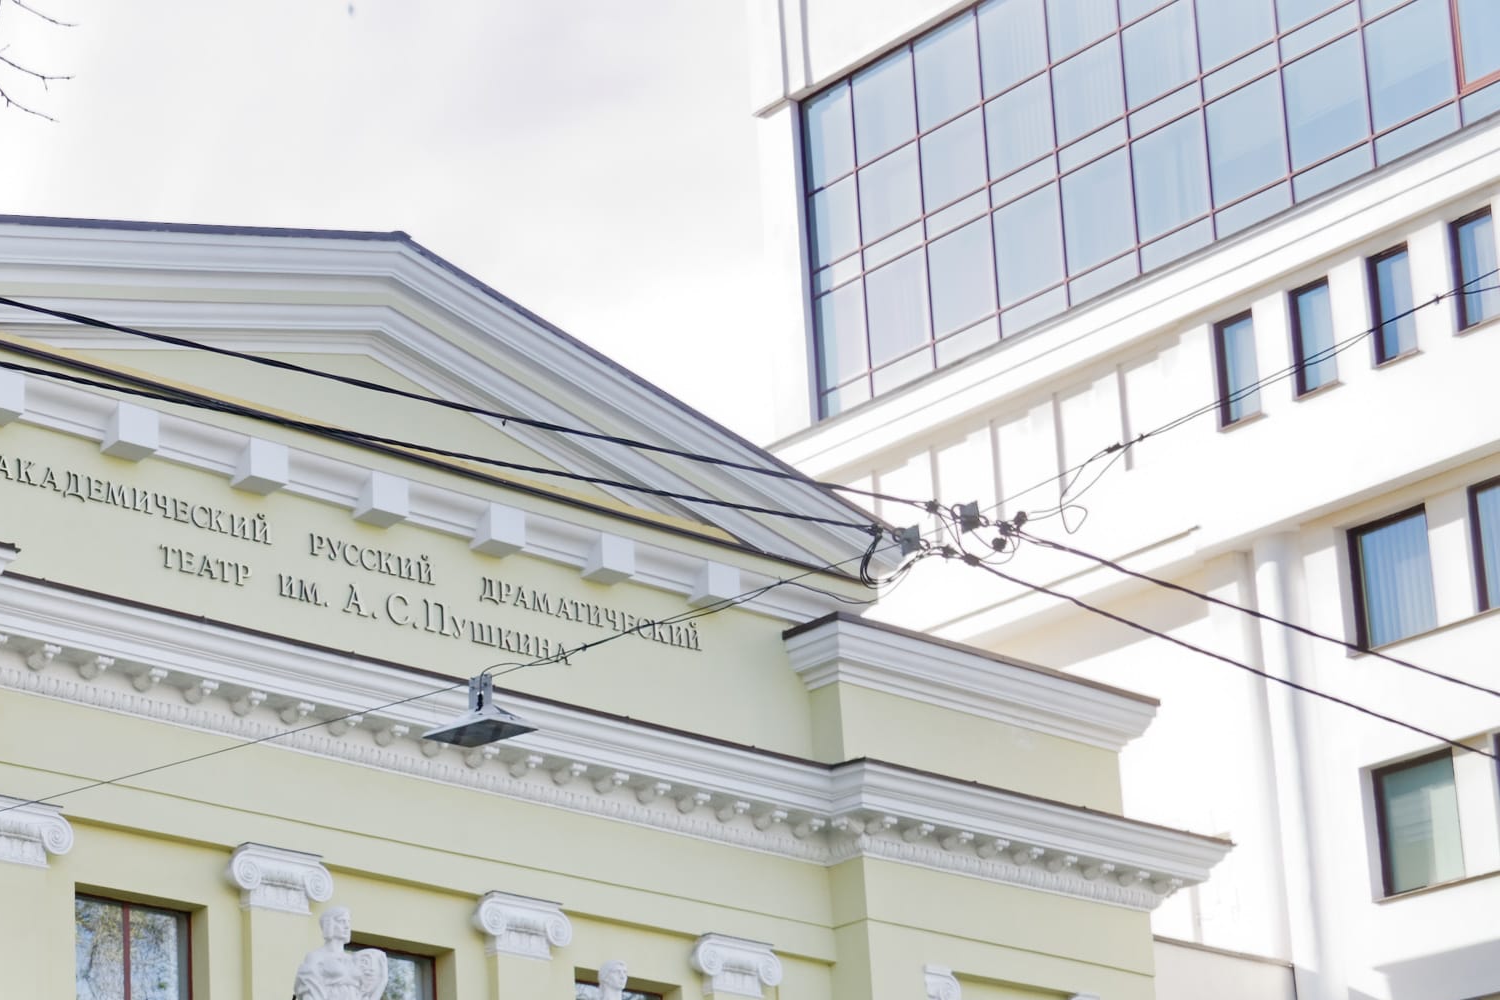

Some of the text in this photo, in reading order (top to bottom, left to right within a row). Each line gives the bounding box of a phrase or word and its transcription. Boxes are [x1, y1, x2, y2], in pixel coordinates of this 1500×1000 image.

[158, 543, 252, 587] ТЕАТР
[308, 532, 436, 586] РУССКИЙ
[479, 576, 702, 651] ДРАМАТИЧЕСКИЙ
